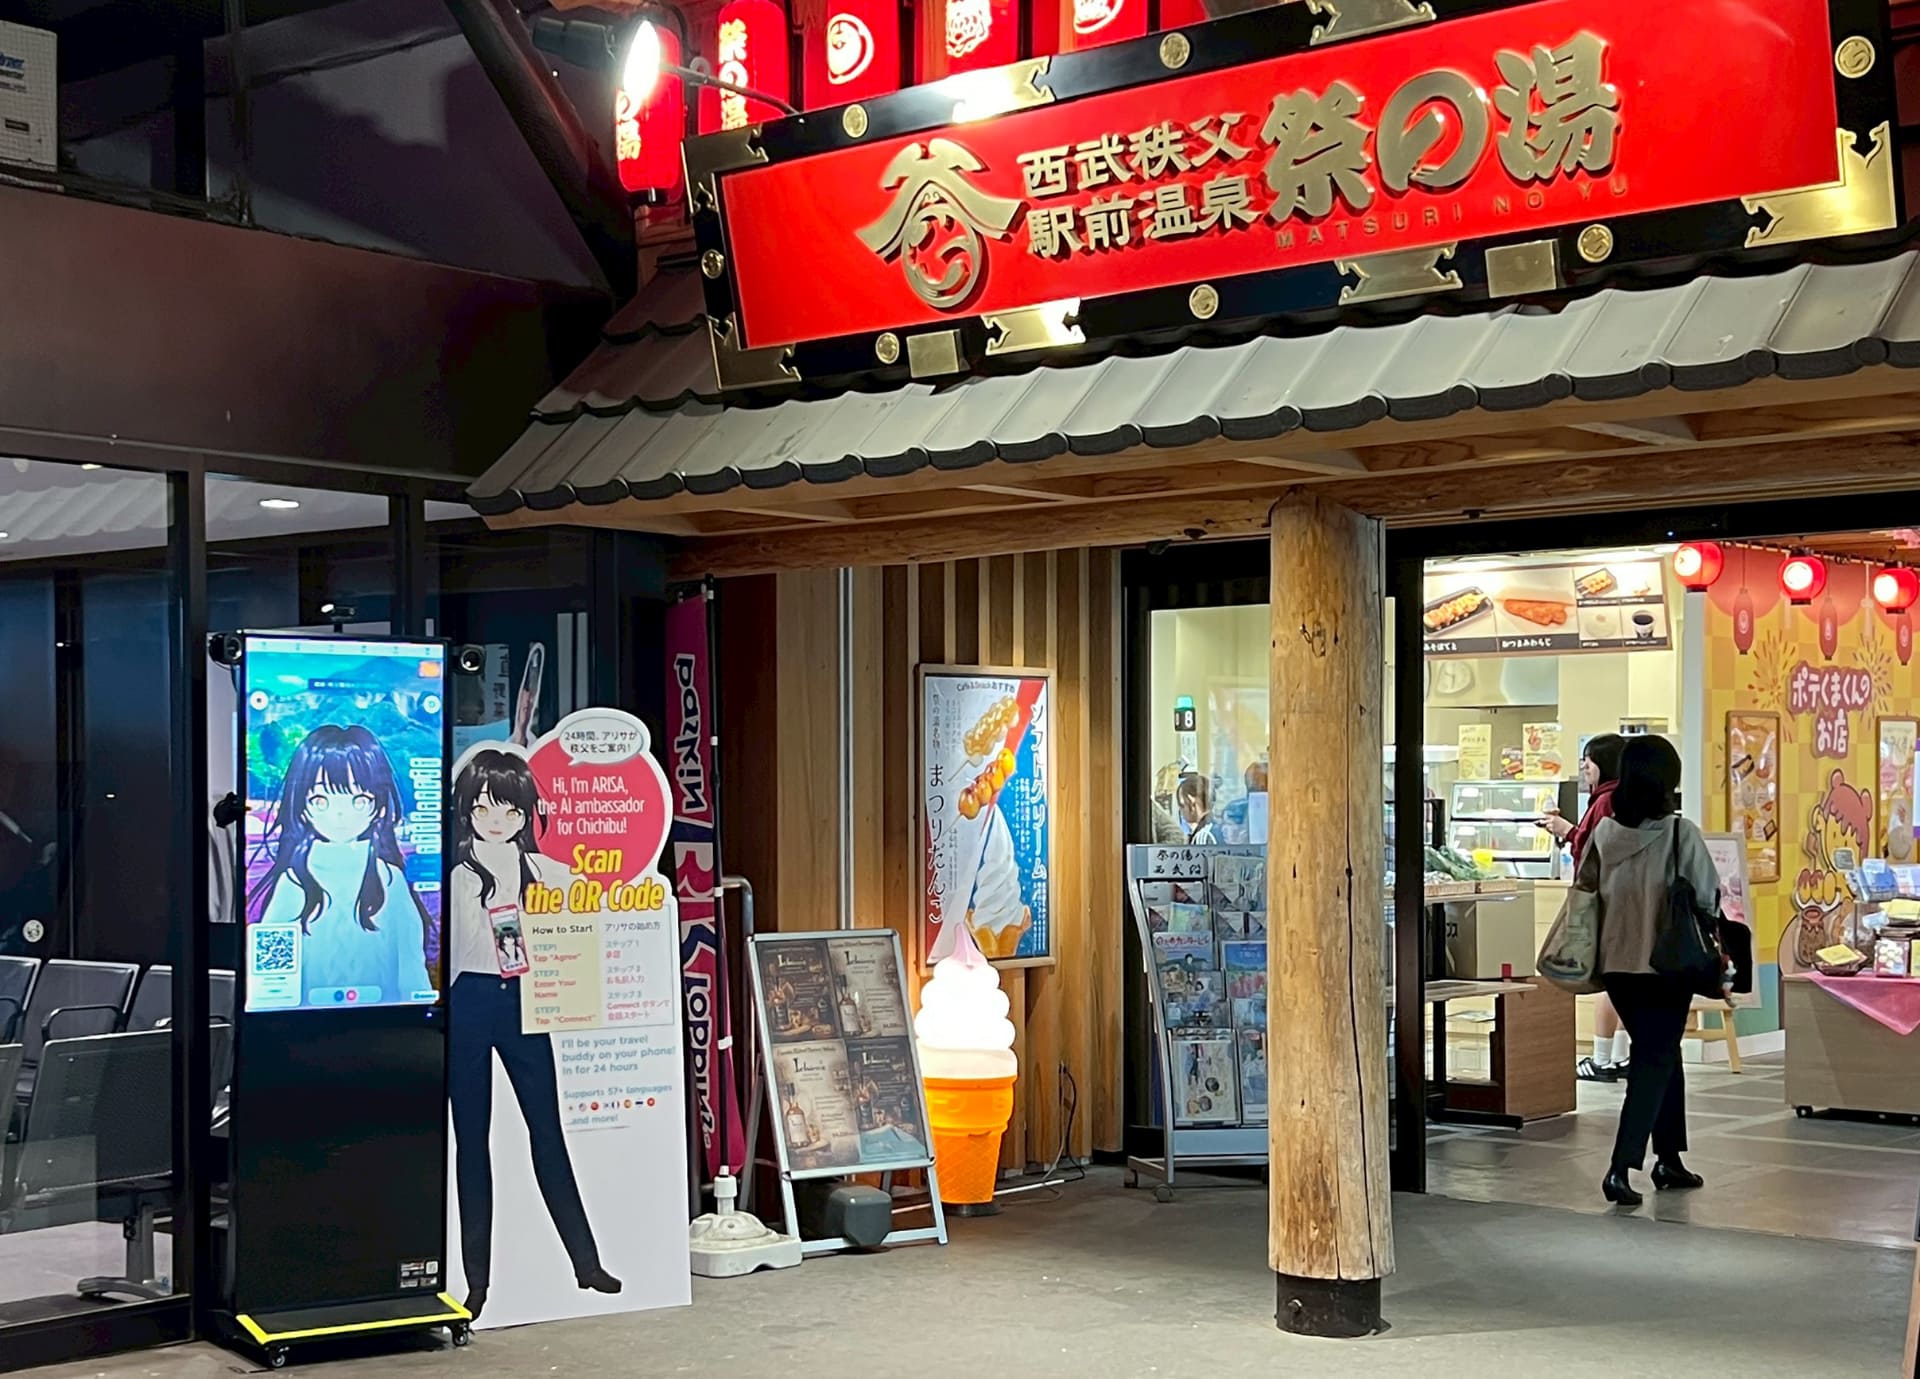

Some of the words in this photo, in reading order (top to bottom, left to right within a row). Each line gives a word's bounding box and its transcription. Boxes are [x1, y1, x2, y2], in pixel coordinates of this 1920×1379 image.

[1262, 30, 1623, 223] 祭の湯
[1016, 112, 1251, 197] 西武秩父
[1026, 171, 1262, 258] 駅前温泉
[1277, 203, 1464, 249] MATSURI
[1494, 190, 1544, 215] NO
[1578, 177, 1628, 201] YU
[1793, 666, 1871, 708] ポテくまくんの
[1817, 708, 1848, 753] お店
[552, 777, 568, 796] Hi,
[571, 777, 589, 794] I'm
[591, 775, 629, 795] ARISA,
[1031, 704, 1047, 880] ソフトクリーム
[537, 797, 557, 816] the
[575, 795, 645, 814] ambassador
[557, 819, 573, 835] for
[576, 818, 628, 835] Chichibu!
[928, 763, 946, 923] まつりだんご
[570, 843, 623, 875] Scan
[524, 882, 564, 914] the
[568, 880, 604, 913] QR
[606, 877, 664, 911] Code
[532, 926, 553, 935] How
[556, 925, 567, 934] to
[569, 924, 593, 933] Start
[562, 1052, 595, 1062] buddy
[599, 1051, 612, 1060] on
[615, 1050, 638, 1060] your
[577, 1038, 590, 1048] be
[594, 1038, 617, 1048] your
[619, 1034, 648, 1045] travel
[575, 1065, 590, 1074] for
[593, 1064, 607, 1073] 24
[610, 1062, 638, 1072] hours
[563, 1089, 605, 1099] Supports
[626, 1085, 673, 1095] languages
